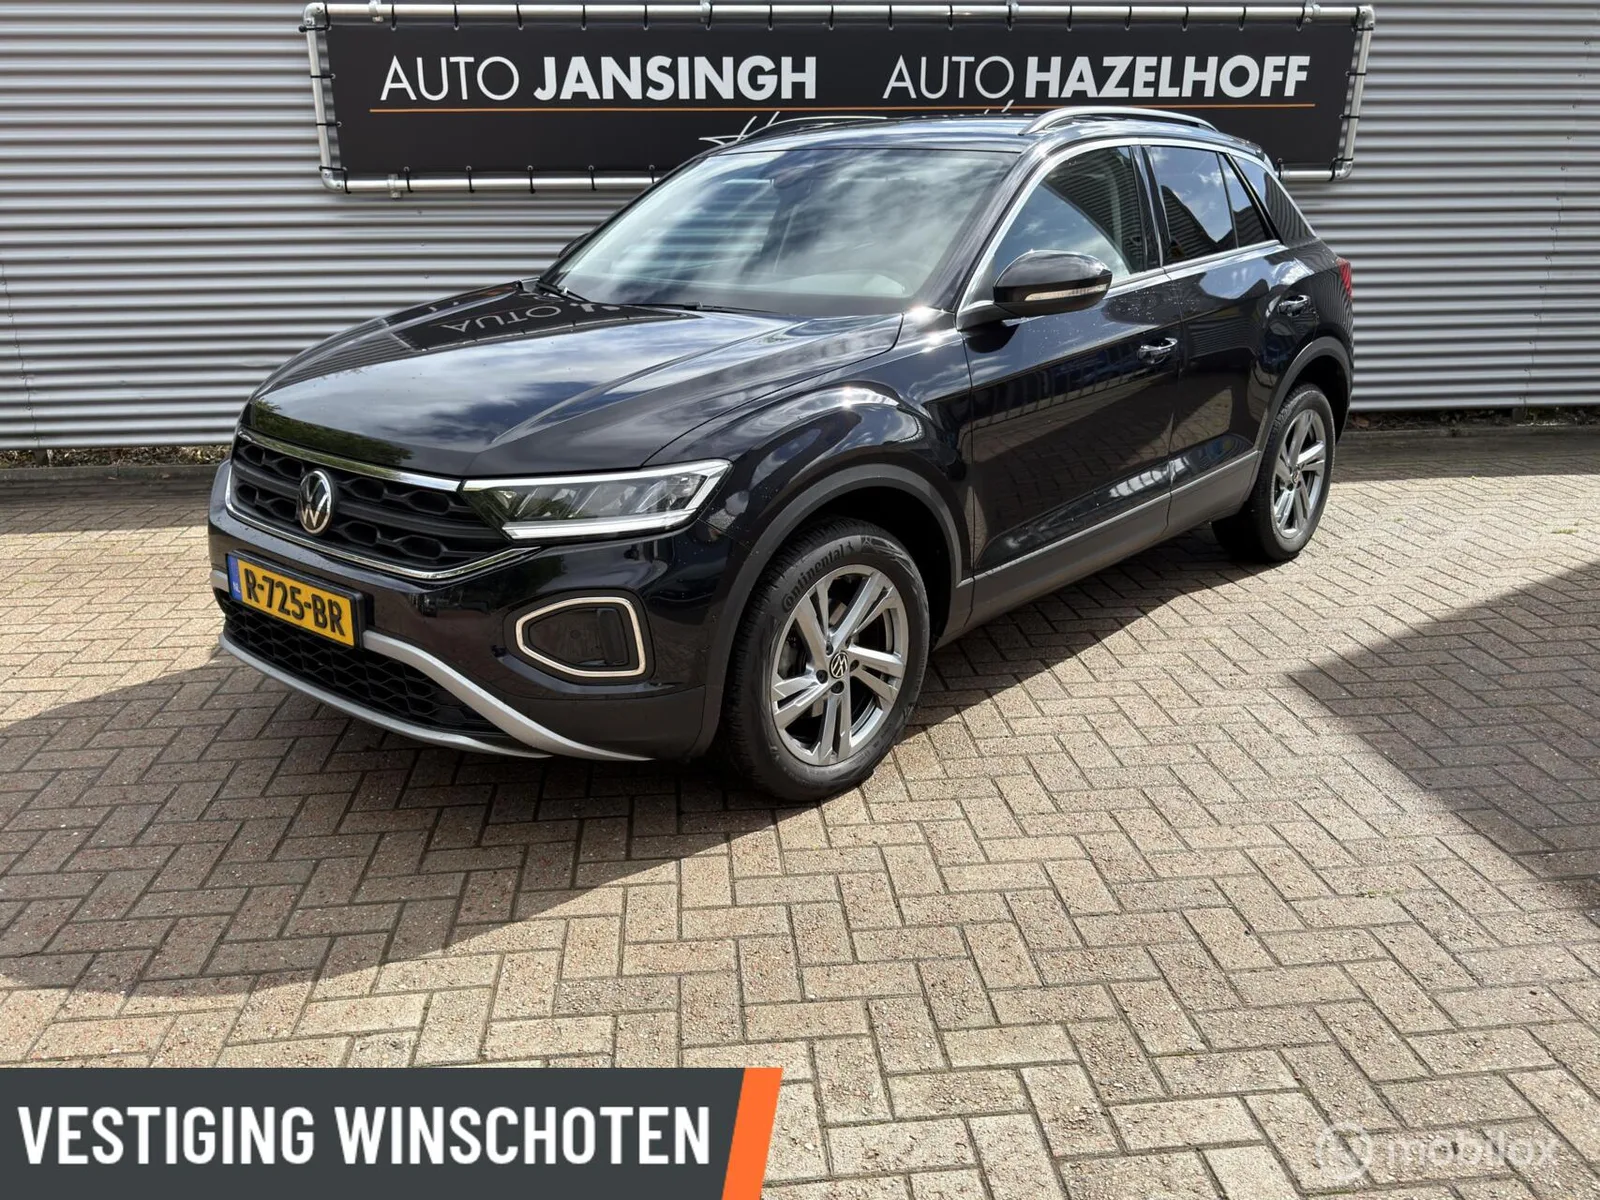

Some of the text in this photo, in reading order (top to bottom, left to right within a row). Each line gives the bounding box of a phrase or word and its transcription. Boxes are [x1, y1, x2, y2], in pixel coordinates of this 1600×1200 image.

[380, 55, 818, 101] AUTO JANSINGH
[882, 54, 1311, 99] AUTO HAZELHOFF
[244, 568, 346, 637] R-725-BR
[781, 546, 847, 613] Continental
